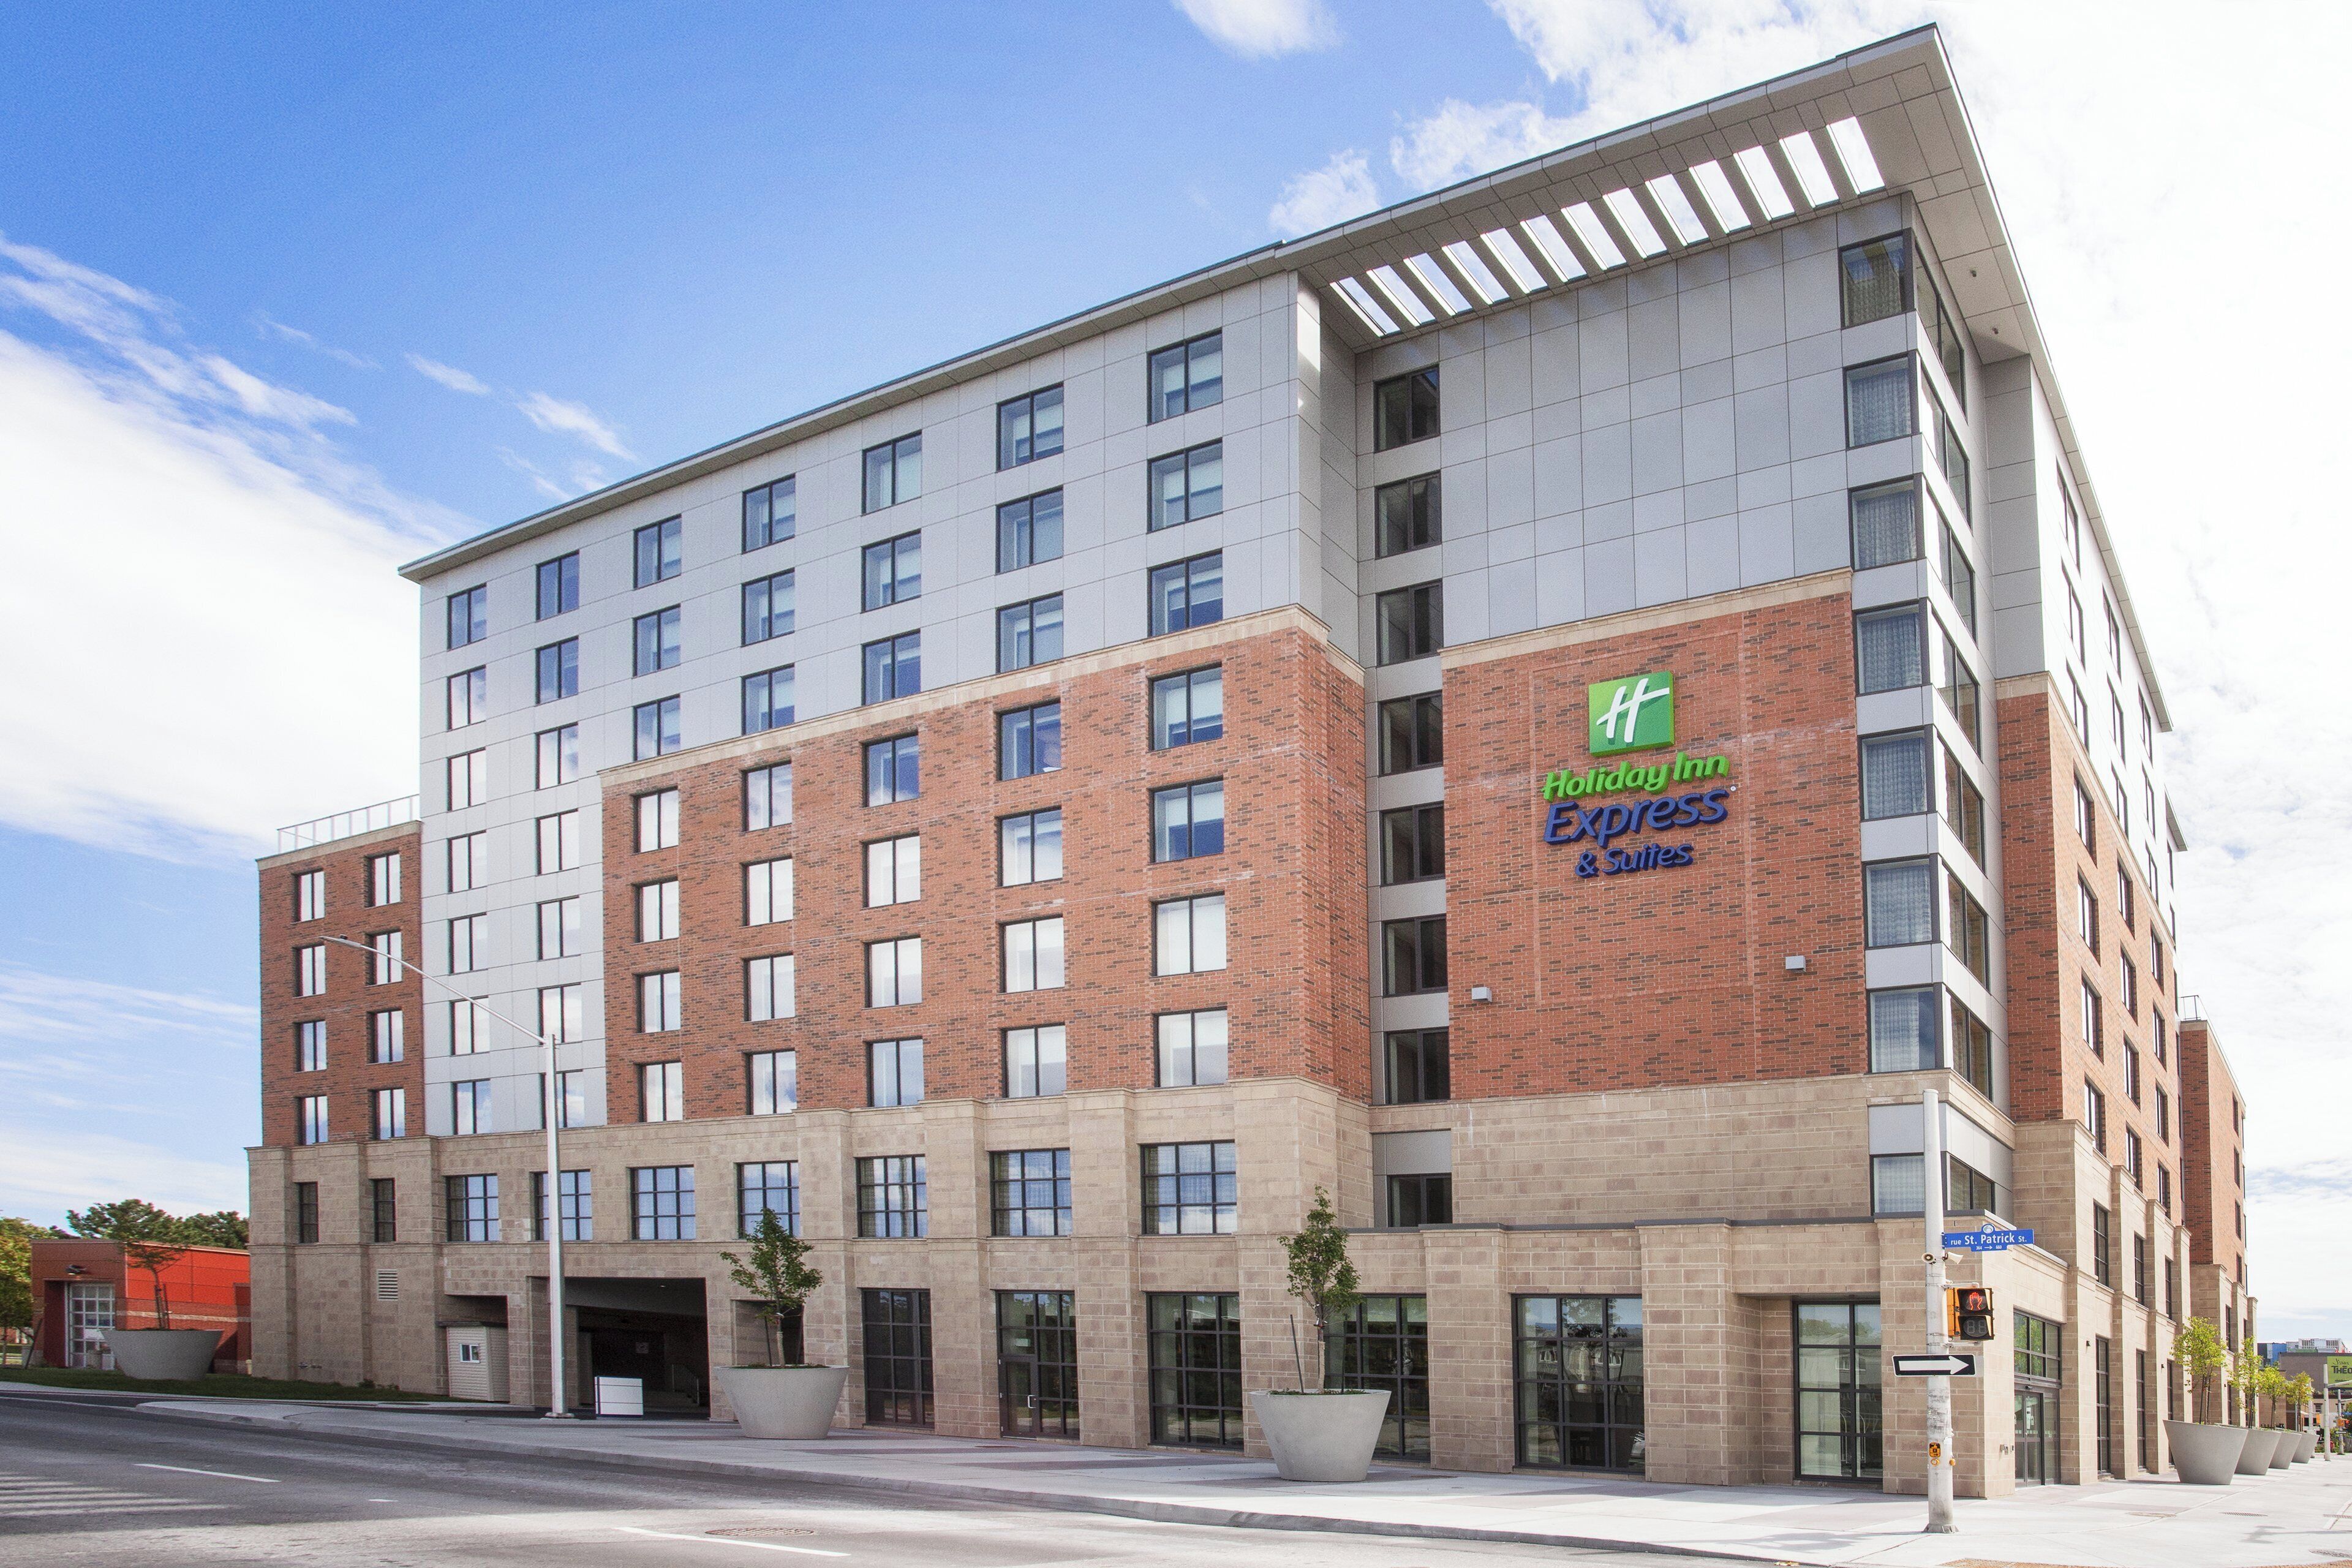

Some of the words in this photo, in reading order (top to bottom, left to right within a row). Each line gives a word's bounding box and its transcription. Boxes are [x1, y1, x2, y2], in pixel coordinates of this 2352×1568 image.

[1541, 761, 1671, 802] Holiday
[1673, 752, 1730, 783] Inn
[1544, 789, 1730, 848] Express
[1575, 850, 1599, 878] &
[1602, 843, 1694, 875] Suites
[1964, 1235, 1977, 1245] St.
[1981, 1232, 2015, 1244] Patrick
